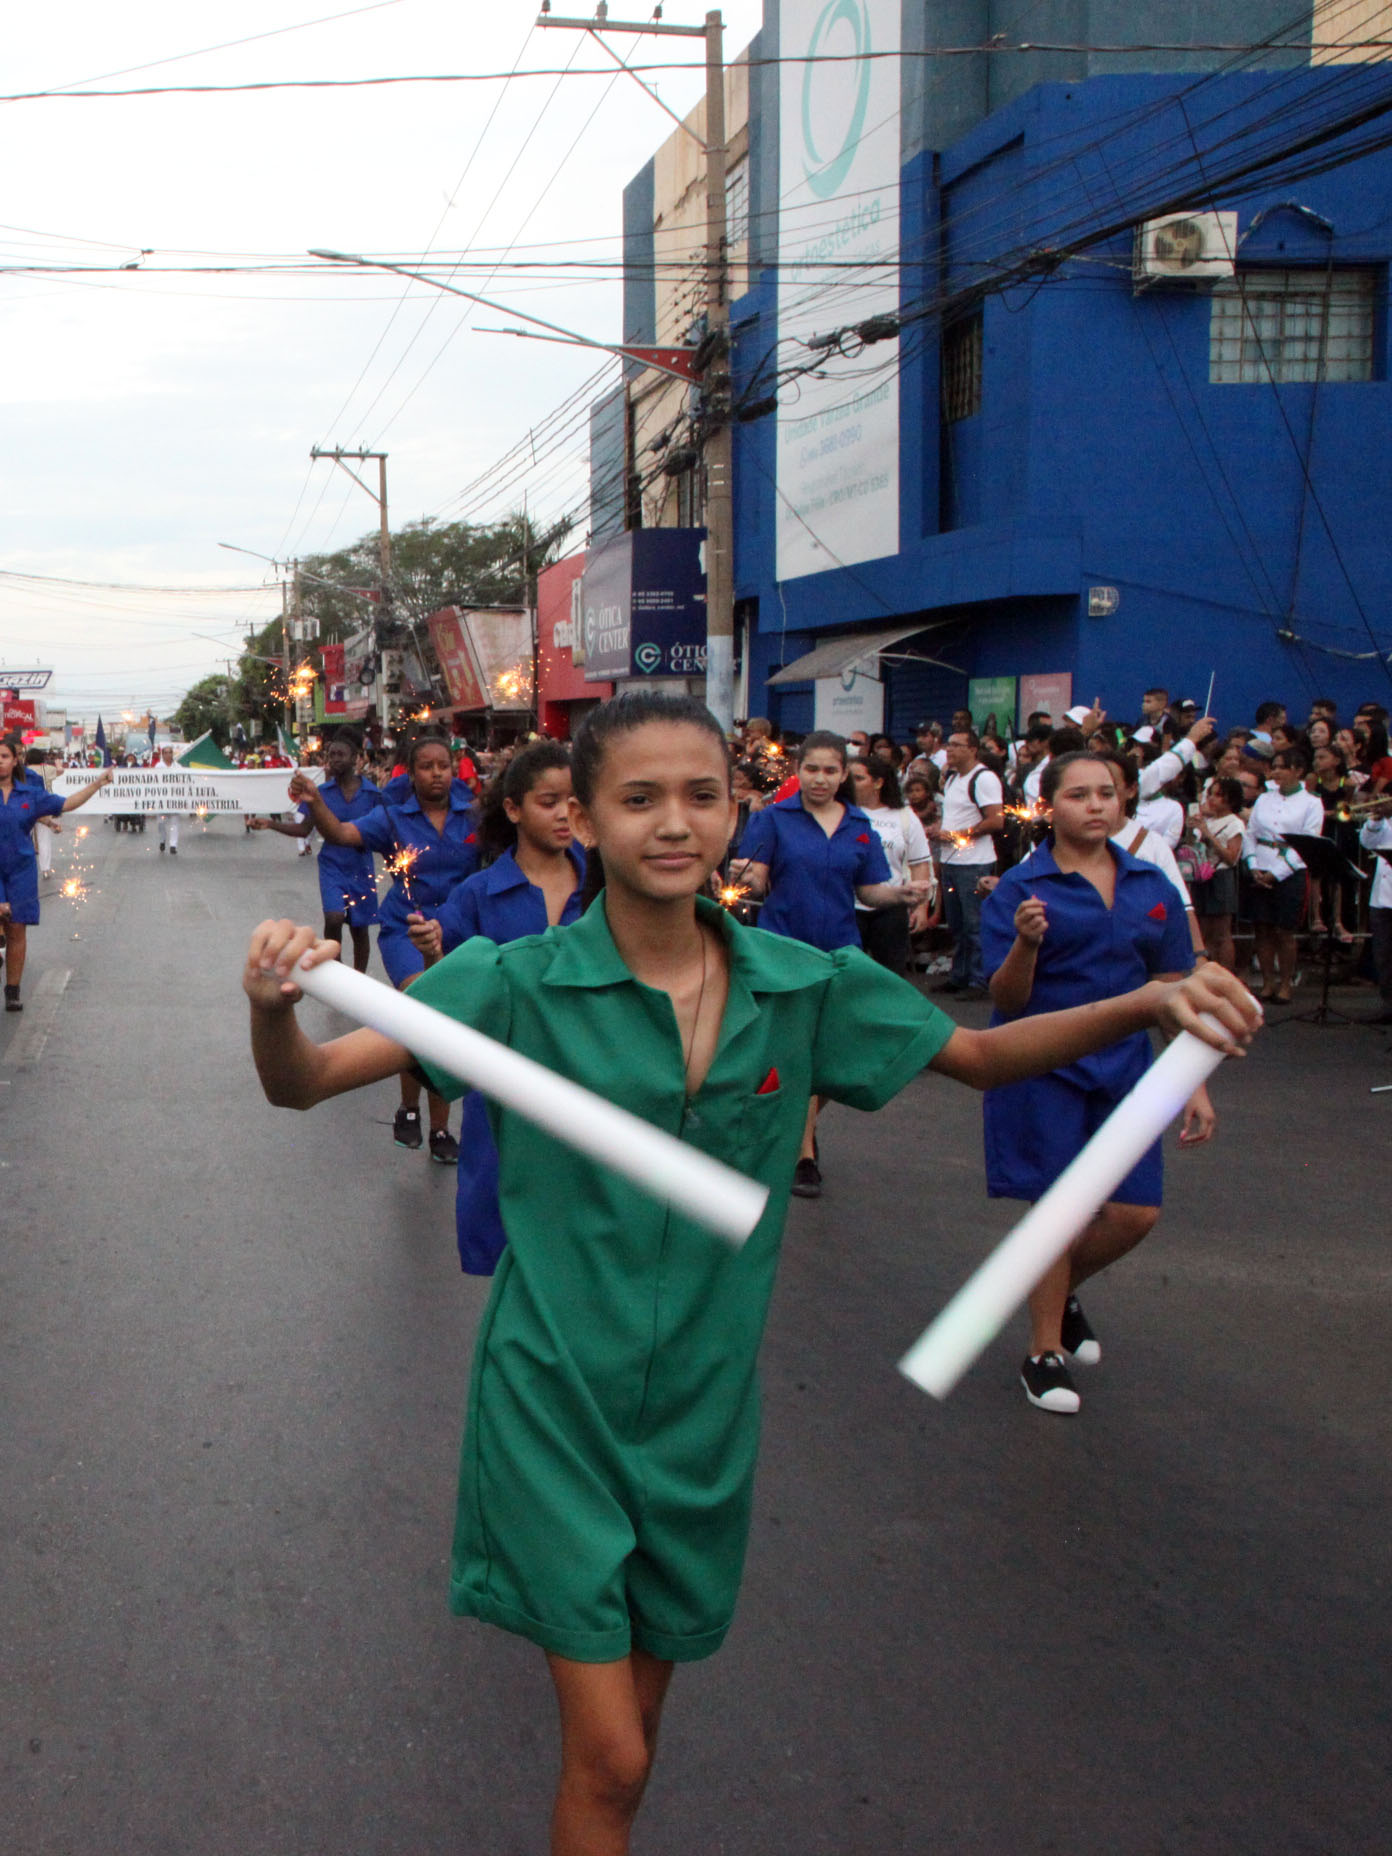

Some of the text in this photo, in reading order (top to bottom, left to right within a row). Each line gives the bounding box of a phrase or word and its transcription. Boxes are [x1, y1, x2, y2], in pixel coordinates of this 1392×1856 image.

[598, 603, 622, 631] ÓTICA
[598, 626, 629, 655] CENTER
[670, 641, 708, 658] ÓTIC
[118, 773, 159, 784] JORNADA
[113, 787, 142, 798] BRAVO
[144, 786, 168, 797] POVO
[170, 786, 185, 797] FOI
[142, 800, 155, 809] FEZ
[158, 799, 164, 809] A
[166, 800, 189, 809] URBE
